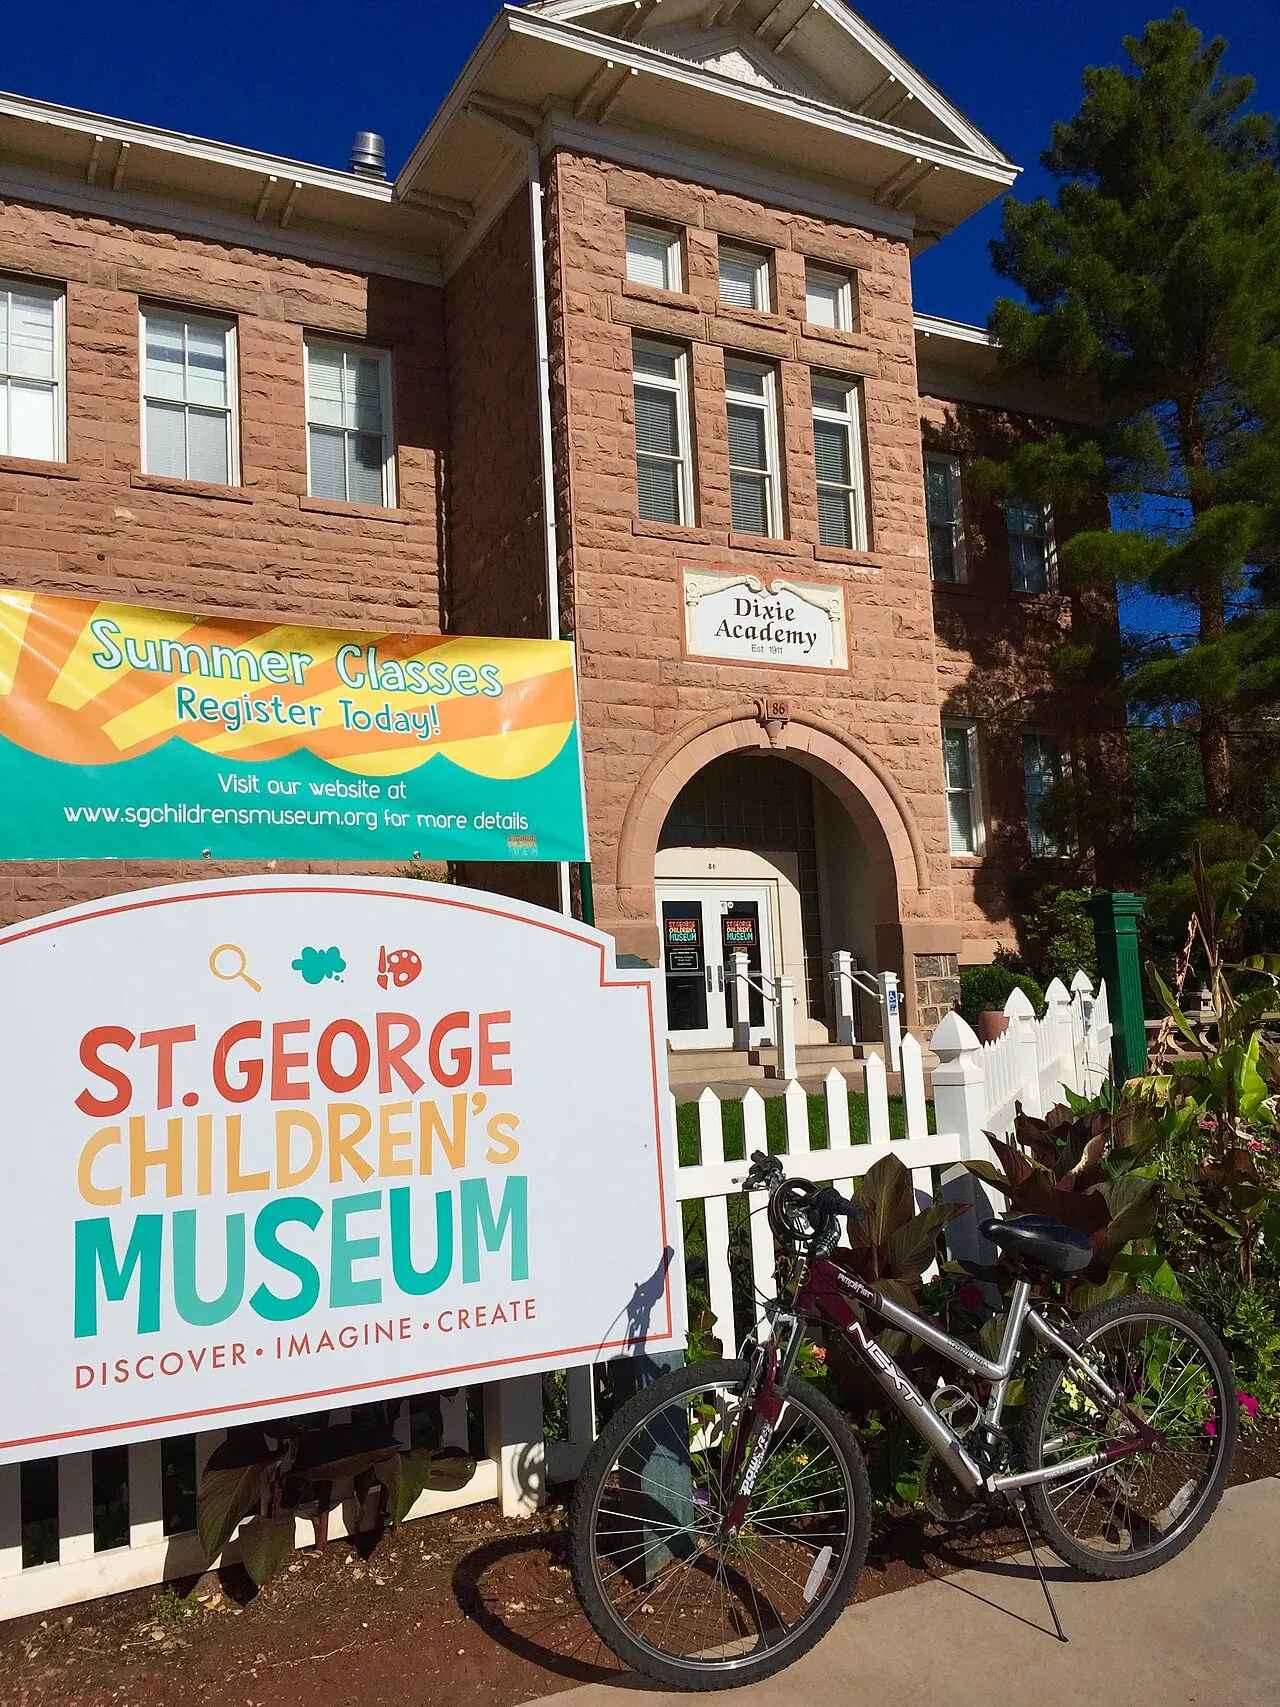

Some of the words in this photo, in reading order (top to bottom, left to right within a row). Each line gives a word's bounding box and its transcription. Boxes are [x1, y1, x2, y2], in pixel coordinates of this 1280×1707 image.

[734, 597, 796, 622] Dixie
[714, 619, 817, 653] Academy
[751, 643, 765, 653] Est
[768, 645, 783, 655] 1911
[90, 619, 314, 685] Summer
[335, 643, 503, 697] Classes
[176, 686, 322, 732] Register
[338, 699, 440, 739] Today!
[772, 702, 786, 715] 86
[217, 773, 261, 794] Visit
[267, 780, 302, 795] our
[309, 779, 381, 799] website
[387, 780, 407, 800] at
[63, 803, 378, 831] www.sgchildrensmuseum.org
[384, 809, 410, 827] for
[416, 814, 467, 829] more
[473, 811, 529, 830] details
[669, 932, 697, 942] MUSEUM
[726, 932, 753, 941] MUSEUM
[73, 1175, 529, 1339] MUSEUM
[75, 1343, 245, 1389] DISCOVER
[276, 1317, 410, 1358] IMAGINE
[437, 1299, 536, 1334] CREATE
[847, 1321, 924, 1407] NEXT
